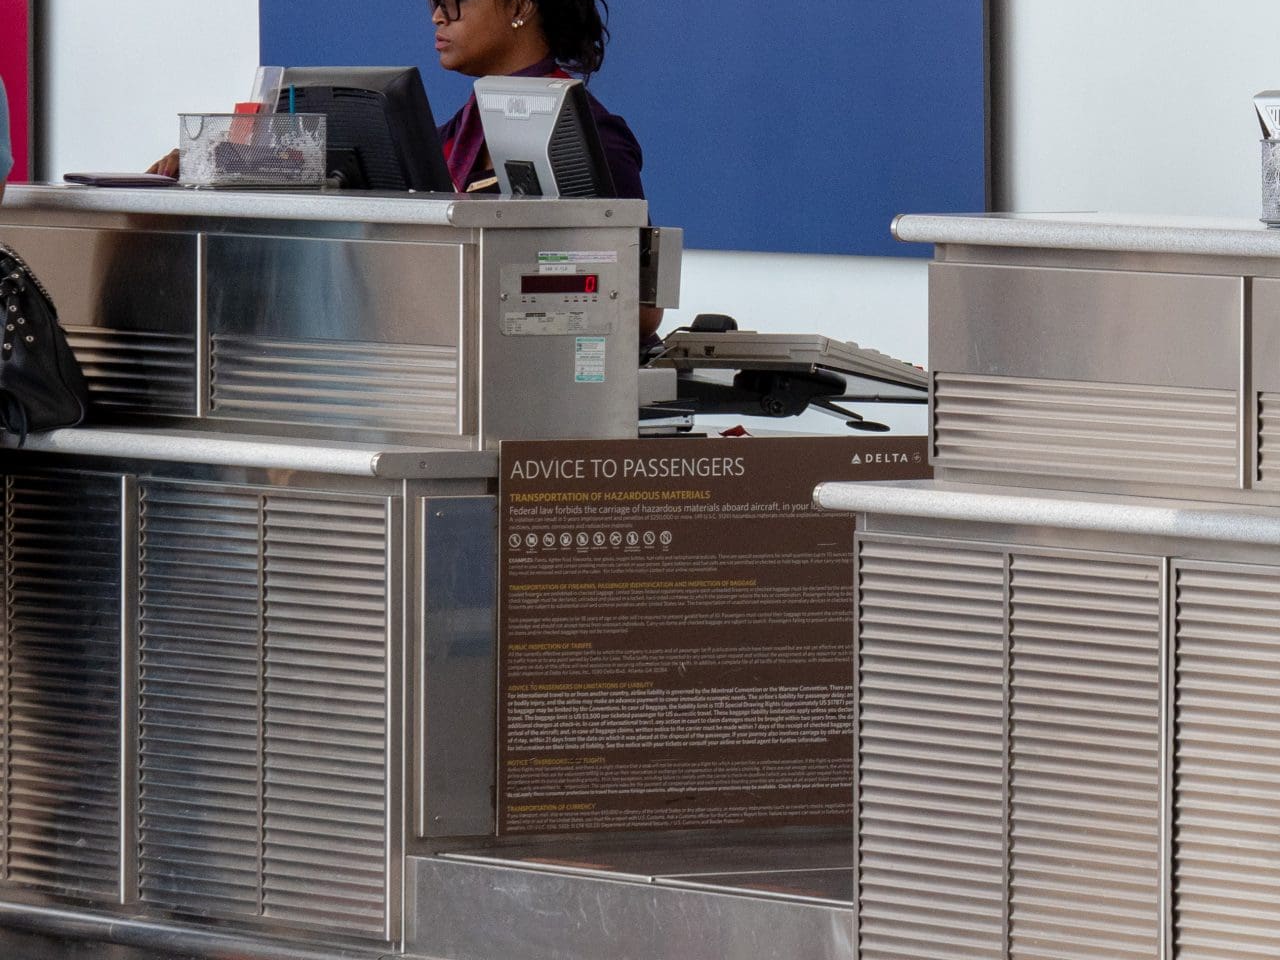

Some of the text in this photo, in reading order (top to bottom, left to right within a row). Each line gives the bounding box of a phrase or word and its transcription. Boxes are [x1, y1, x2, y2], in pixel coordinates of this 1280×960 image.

[584, 275, 596, 293] 0
[865, 453, 909, 464] DELTA
[510, 457, 745, 480] ADVICE TO PASSENGERS
[509, 490, 711, 503] TRANSPORTATION OF HAZARDOUS MATERIALS
[509, 506, 538, 516] Federal
[539, 505, 553, 515] law
[555, 505, 582, 514] forbids
[584, 505, 597, 514] the
[598, 505, 630, 516] carriage
[632, 504, 641, 513] of
[642, 504, 682, 513] hazardous
[684, 503, 720, 513] materials
[722, 503, 749, 512] aboard
[782, 501, 790, 511] in
[791, 503, 809, 513] your
